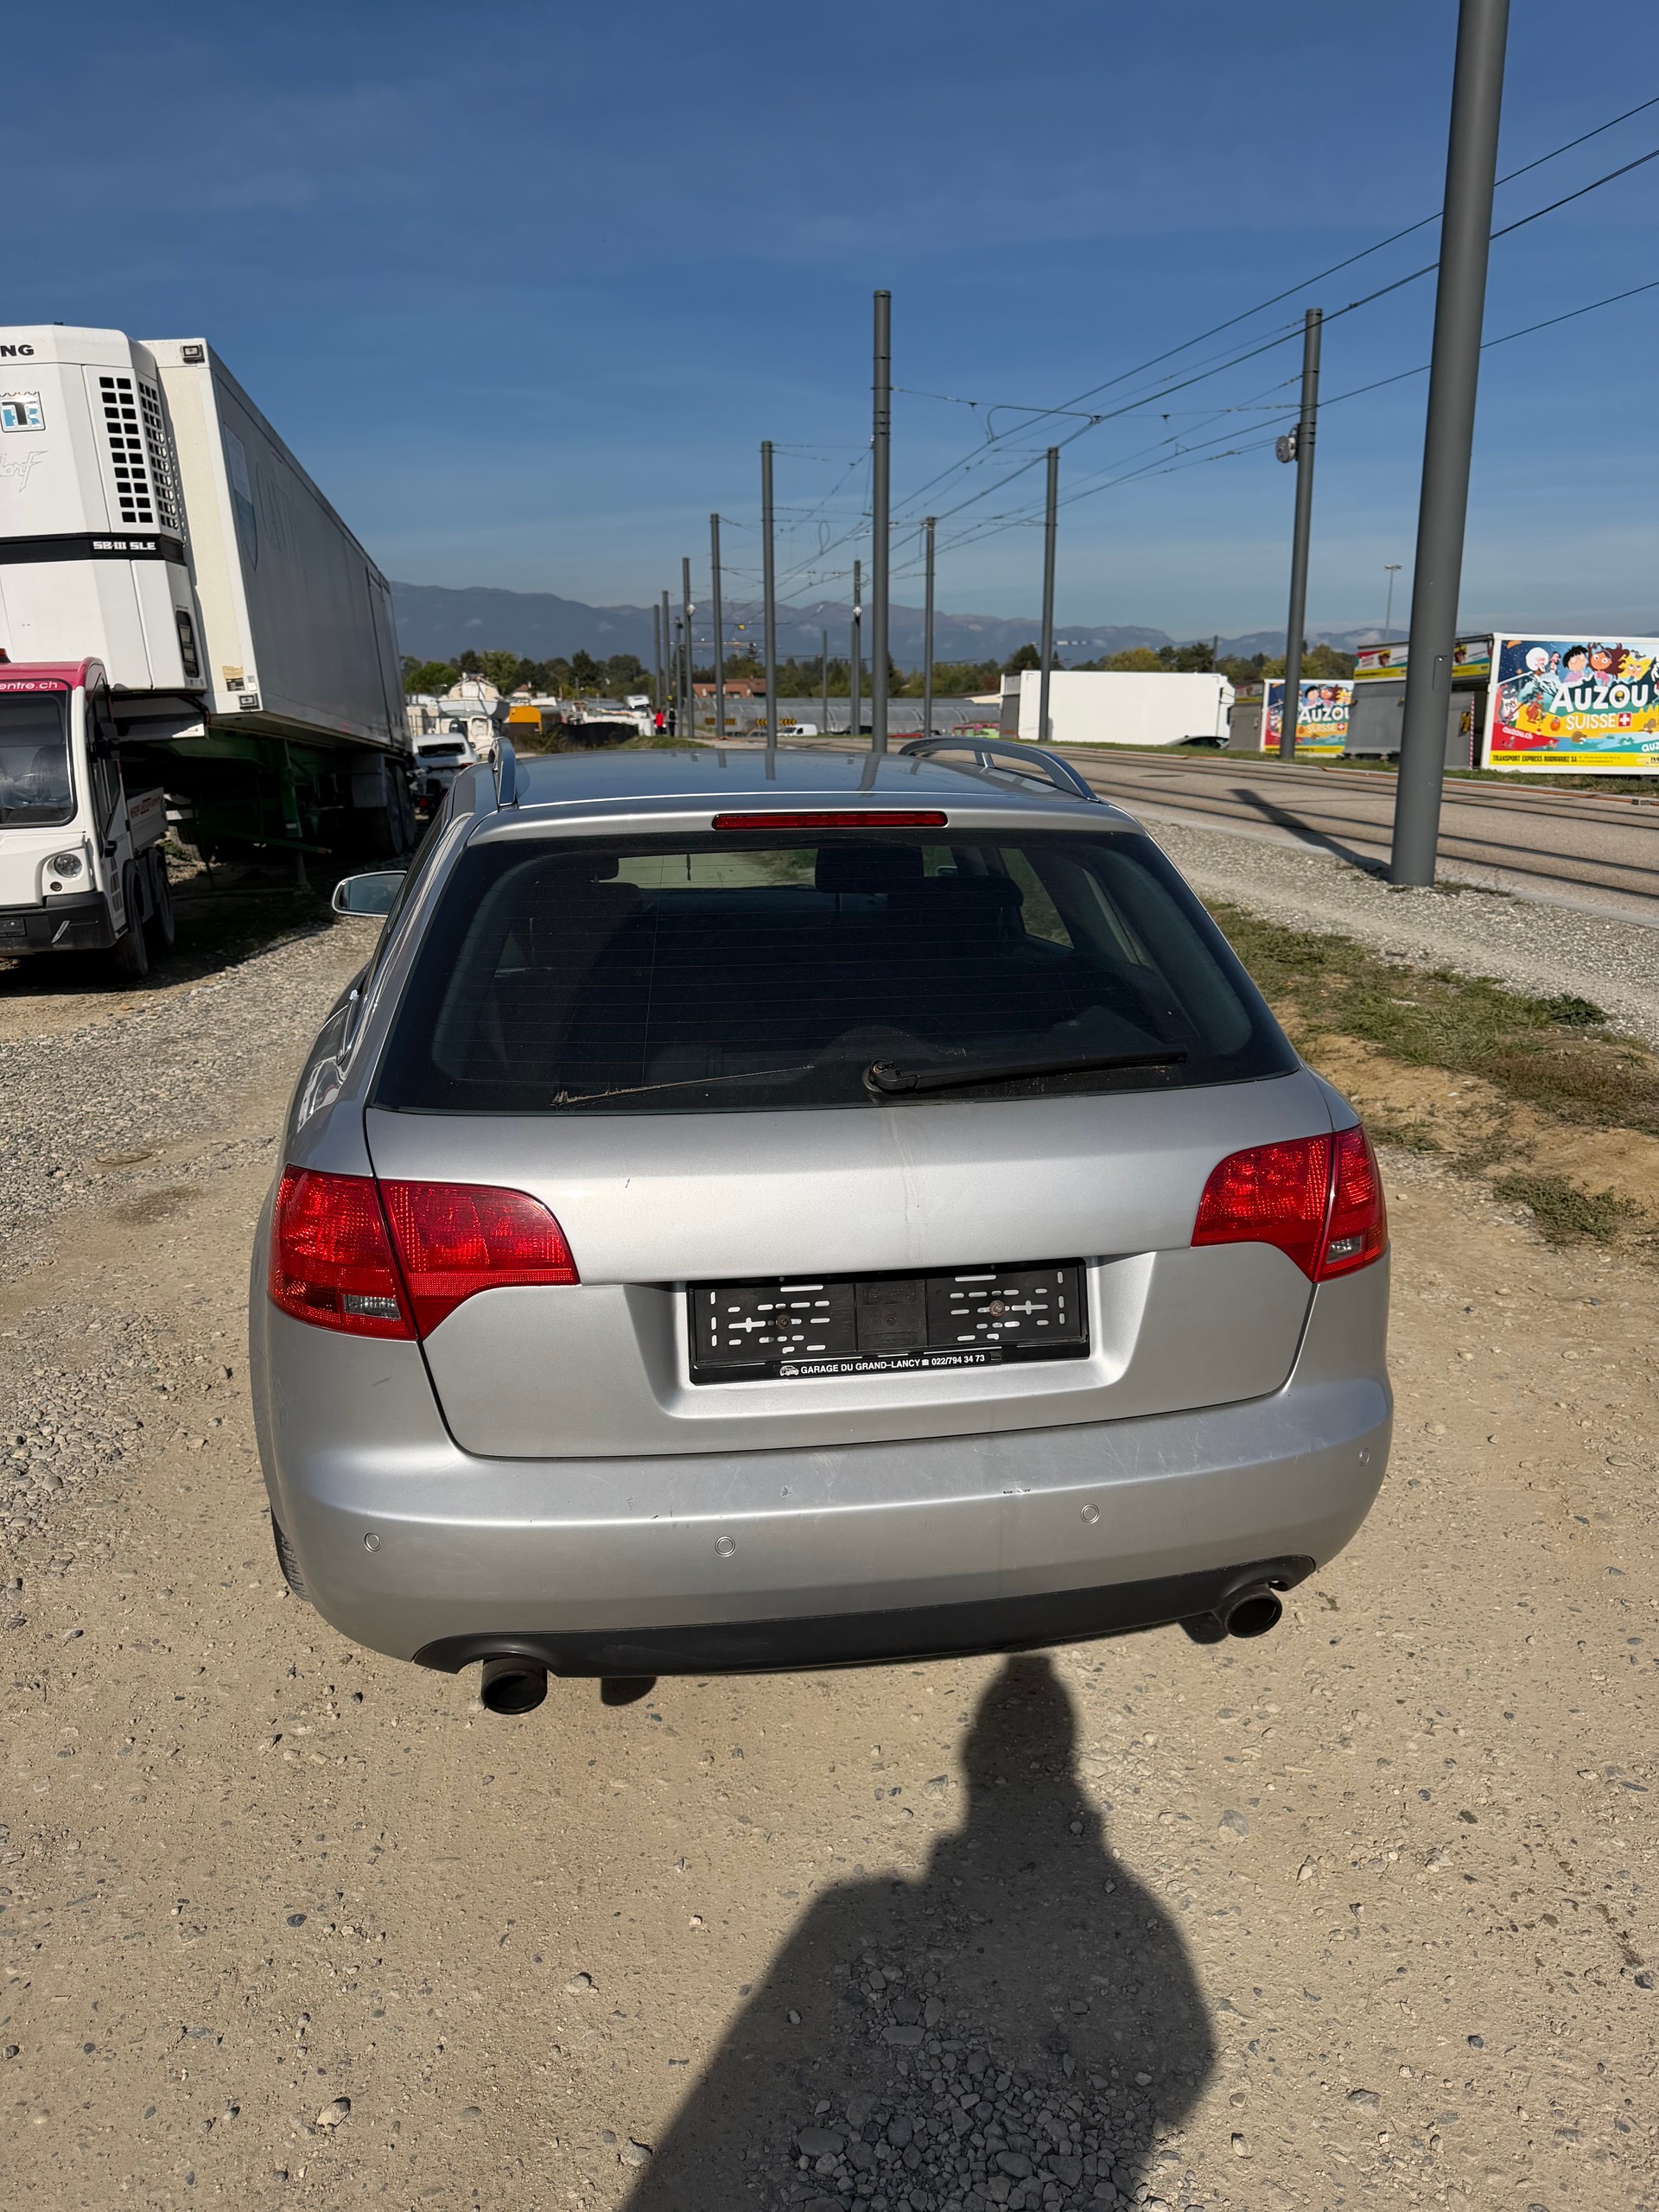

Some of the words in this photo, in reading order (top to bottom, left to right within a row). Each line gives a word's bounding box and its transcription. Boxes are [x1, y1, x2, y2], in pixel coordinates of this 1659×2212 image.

[0, 344, 35, 357] NG
[129, 542, 156, 550] SLE
[1549, 683, 1649, 714] AUZOU
[1566, 713, 1617, 731] SUISSE
[800, 1364, 839, 1374] GARAGE
[855, 1359, 920, 1370] GRAND-LANCY
[931, 1356, 962, 1365] 022/794
[963, 1355, 974, 1363] 34
